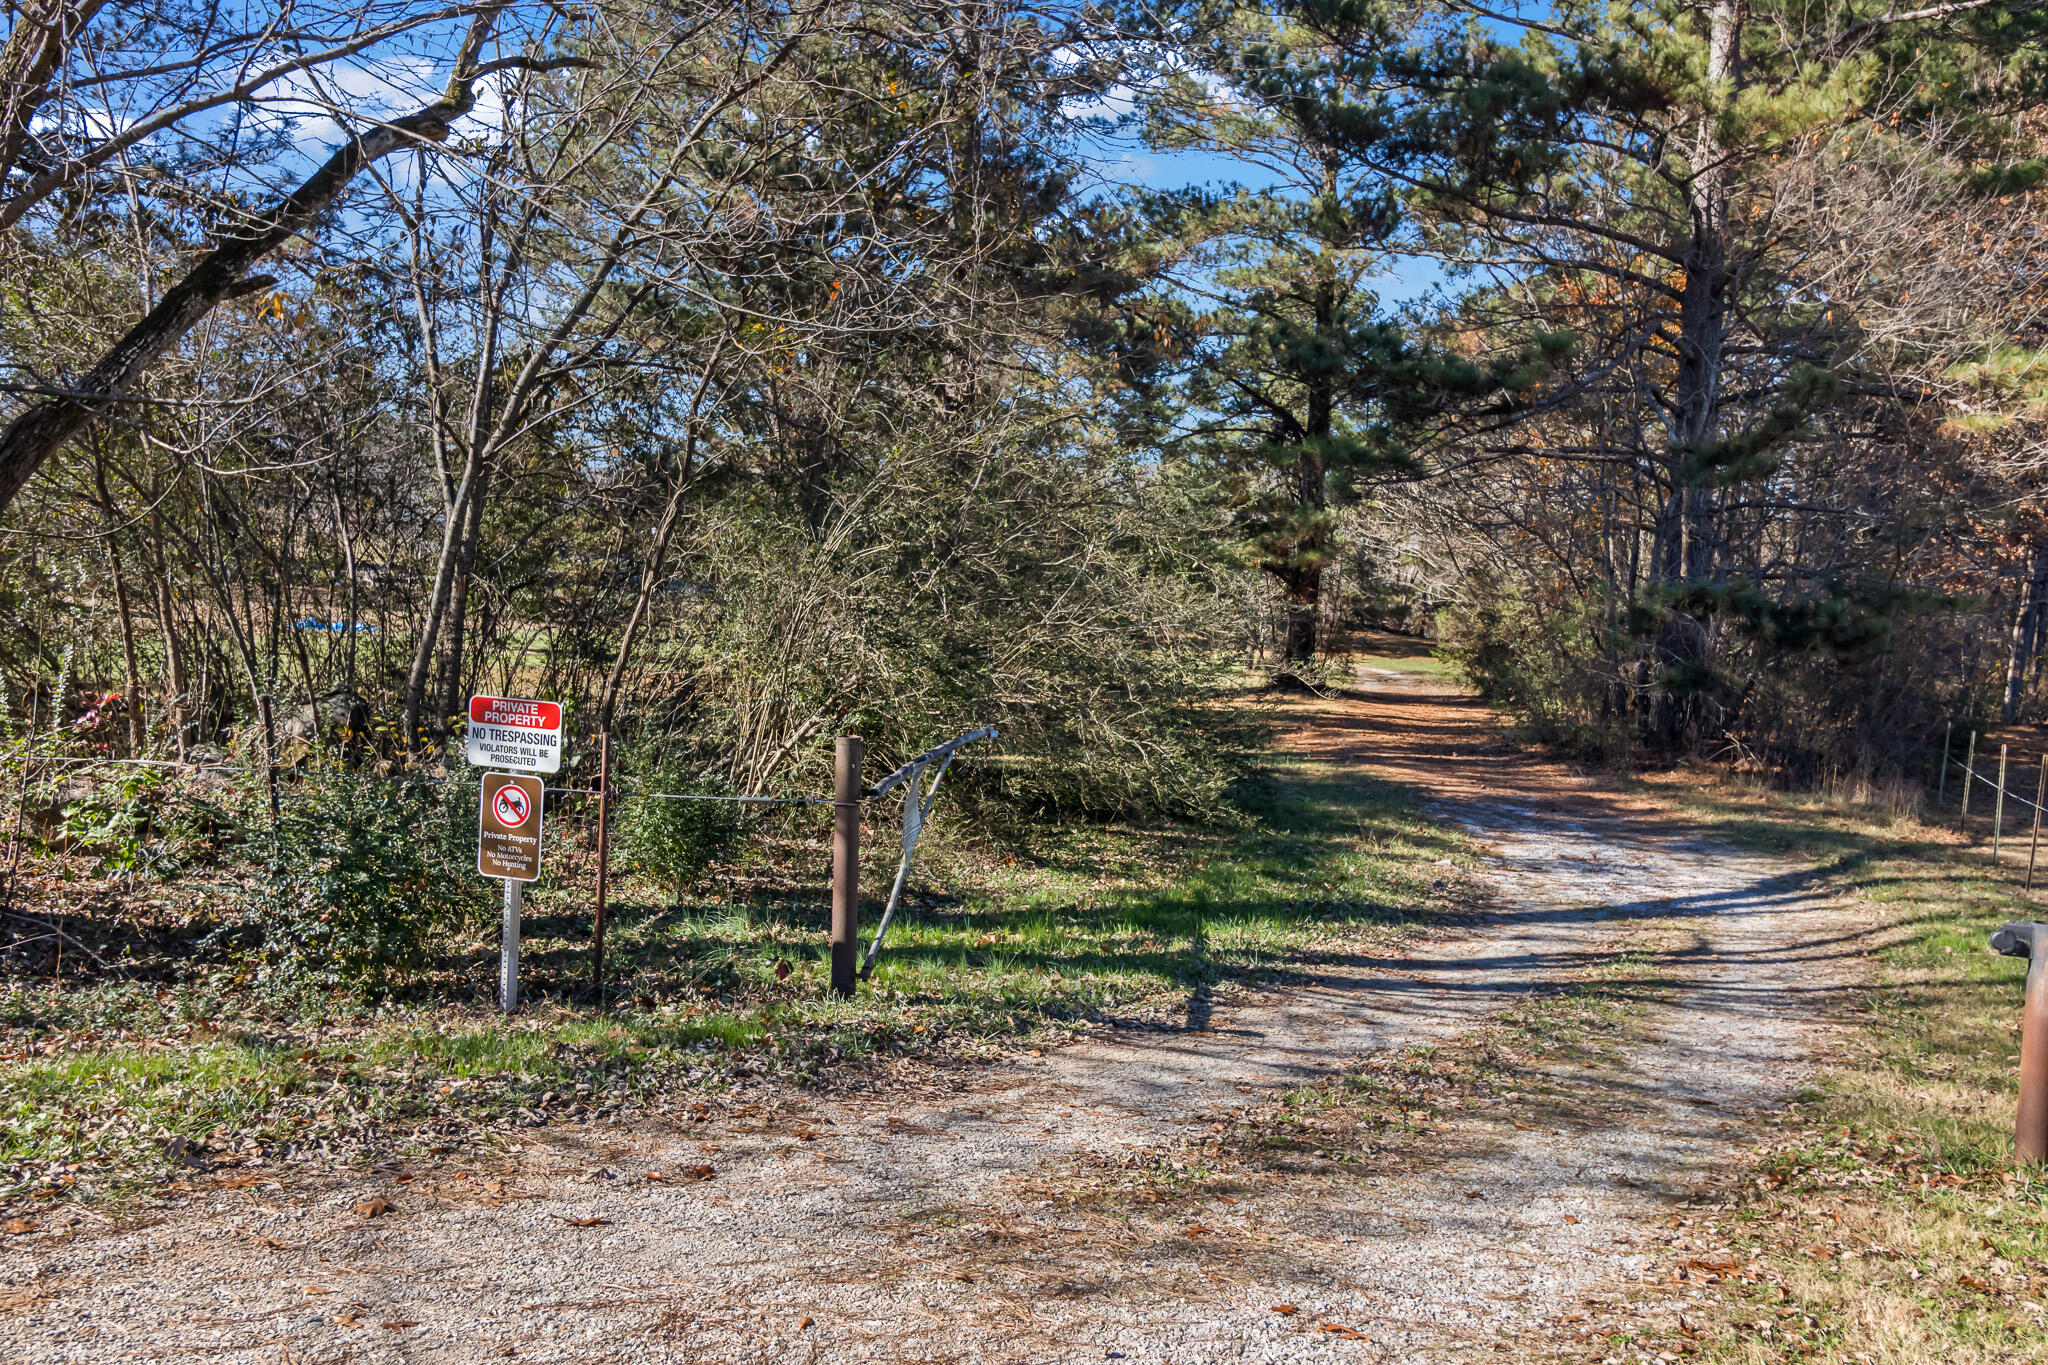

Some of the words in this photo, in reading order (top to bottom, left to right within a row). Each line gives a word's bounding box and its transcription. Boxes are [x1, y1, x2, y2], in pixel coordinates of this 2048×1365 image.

[492, 700, 539, 715] PRIVATE
[484, 711, 546, 727] PROPERTY
[472, 727, 486, 740] NO
[489, 728, 557, 747] TRESPASSING
[479, 743, 518, 755] VIOLATORS
[520, 747, 537, 757] WILL
[539, 749, 549, 758] BE
[490, 754, 537, 767] PROSECUTED
[483, 831, 507, 841] Private
[508, 833, 538, 846] Property
[486, 850, 496, 858] No
[496, 852, 533, 863] Motorcycles
[497, 844, 507, 852] No
[507, 845, 523, 854] ATVs
[492, 858, 502, 866] No
[502, 860, 527, 871] Hunting
